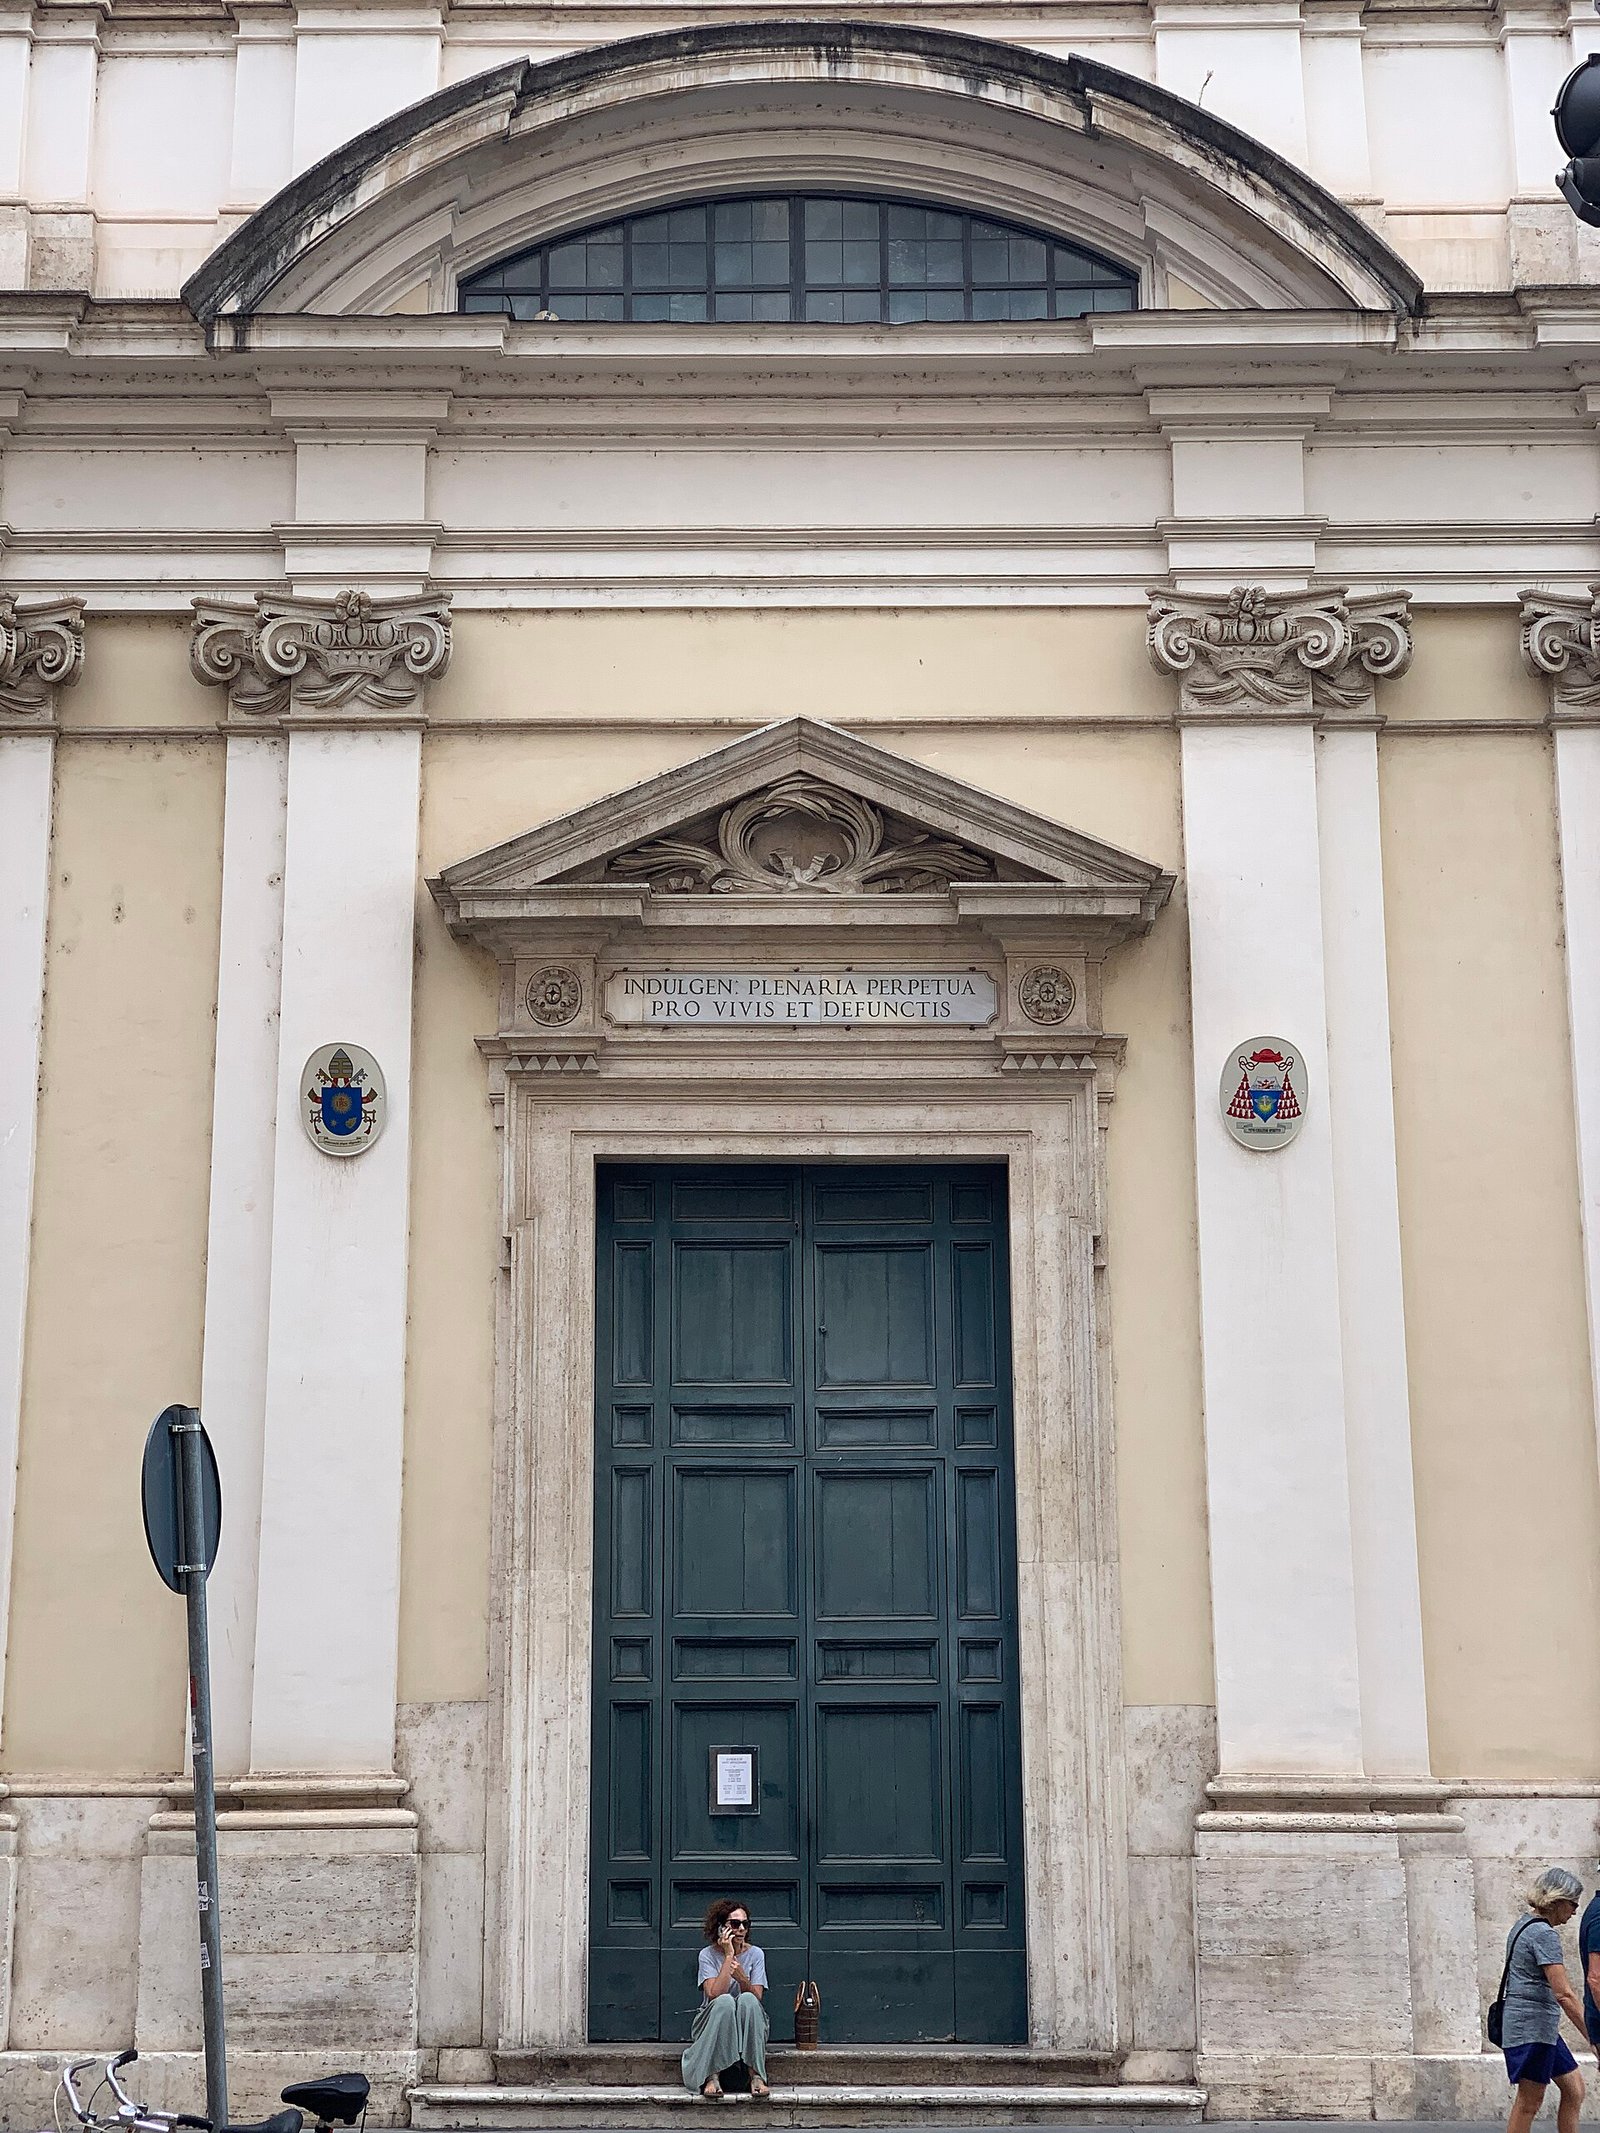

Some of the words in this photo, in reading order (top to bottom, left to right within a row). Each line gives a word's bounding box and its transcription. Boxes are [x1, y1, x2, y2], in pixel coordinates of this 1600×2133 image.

[748, 979, 858, 996] PLENARIA
[867, 979, 976, 996] PERPETUA
[651, 1000, 701, 1017] PRO
[713, 1001, 775, 1018] VIVIS
[786, 1001, 813, 1018] ET
[824, 1001, 951, 1018] DEFUNCTIS
